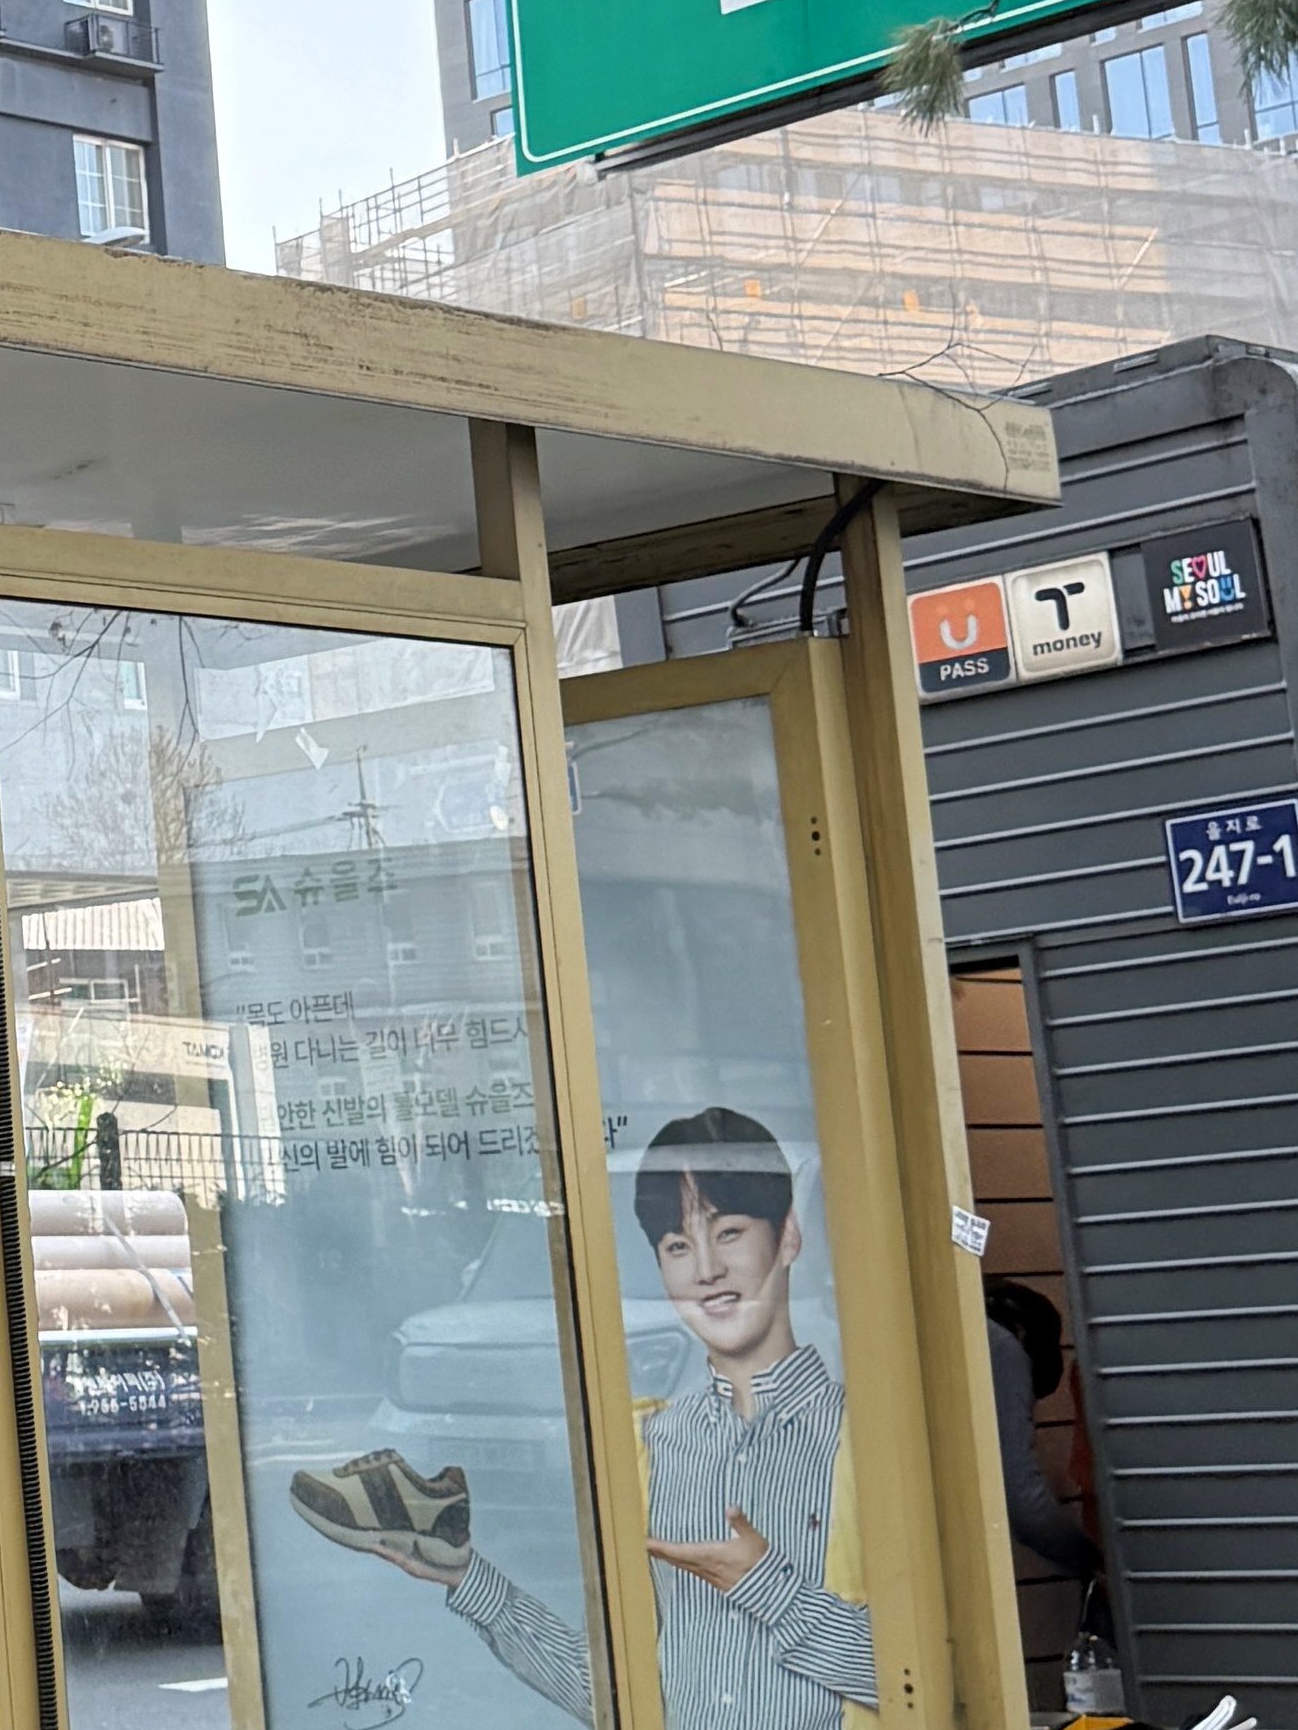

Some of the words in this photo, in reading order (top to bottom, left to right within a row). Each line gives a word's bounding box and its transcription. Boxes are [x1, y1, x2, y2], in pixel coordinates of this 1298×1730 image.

[1033, 631, 1102, 657] money
[939, 657, 990, 681] PASS
[1178, 833, 1297, 894] 247-1
[289, 990, 355, 1024] 아픈데
[294, 1035, 360, 1067] 다니는
[364, 1027, 407, 1060] 길이
[261, 1100, 317, 1132] 안한
[322, 1092, 387, 1128] 신발의
[267, 1139, 320, 1174] 신의
[326, 1137, 371, 1170] 발에
[375, 1132, 418, 1167] 힘이
[425, 1130, 470, 1162] 되어
